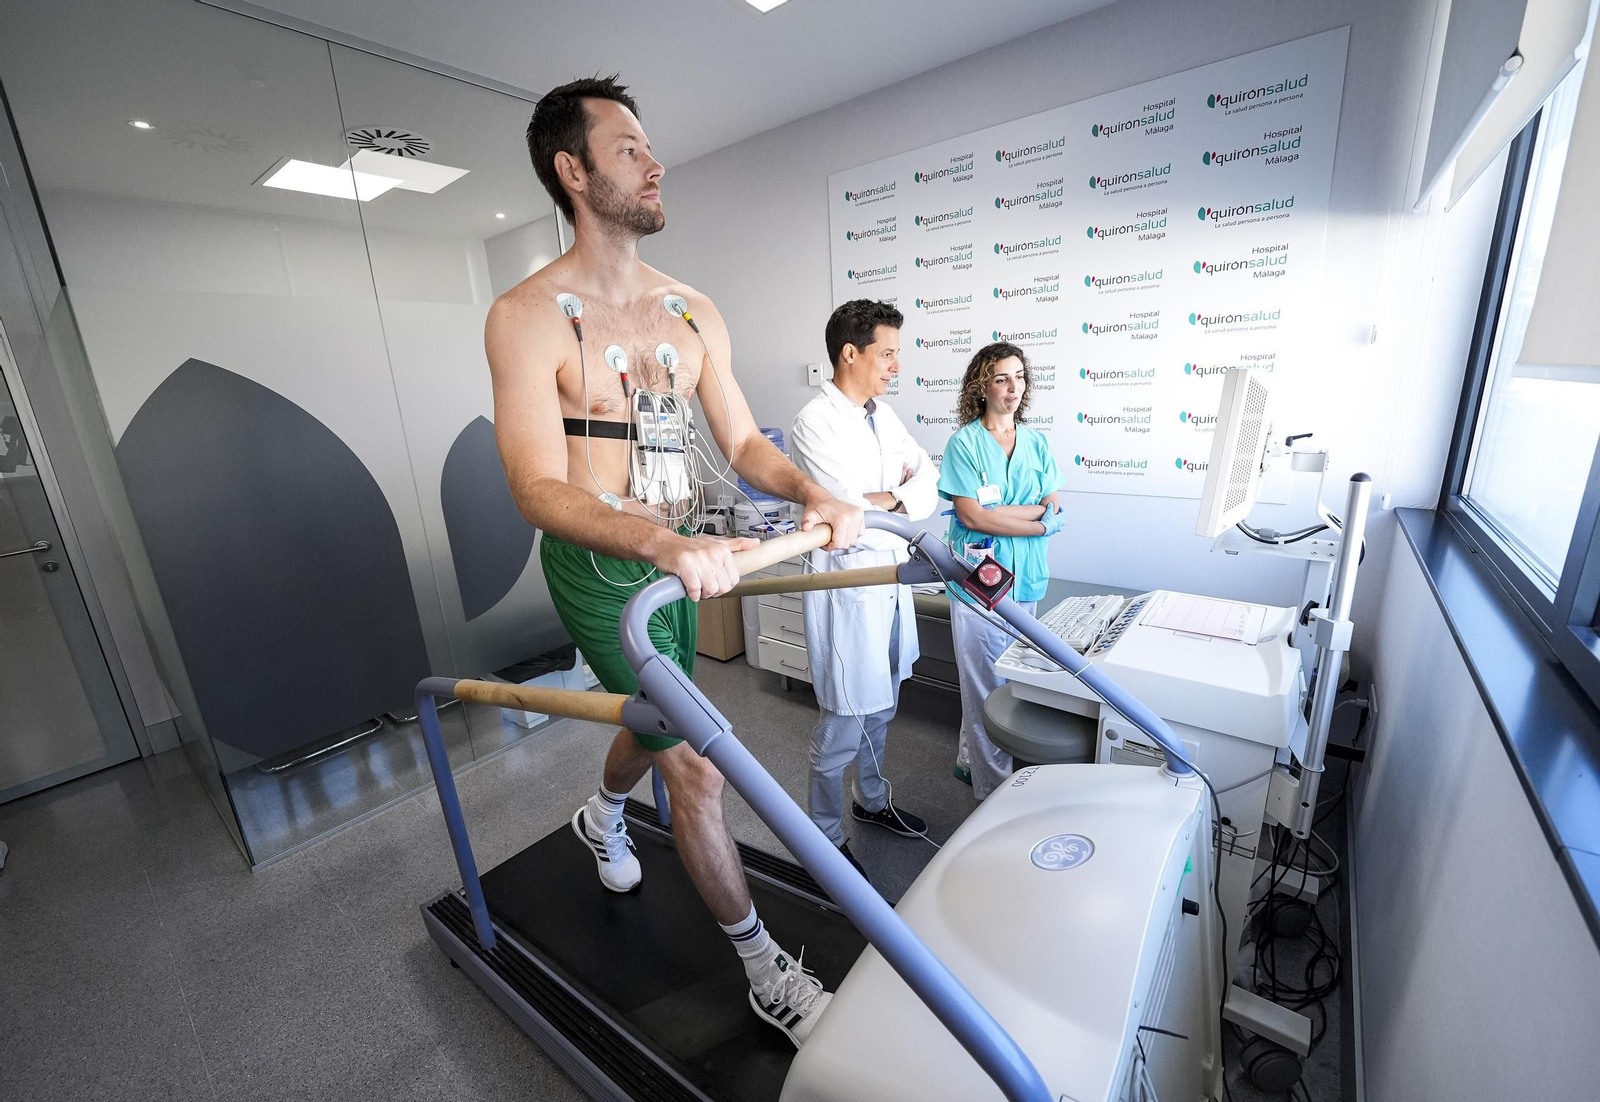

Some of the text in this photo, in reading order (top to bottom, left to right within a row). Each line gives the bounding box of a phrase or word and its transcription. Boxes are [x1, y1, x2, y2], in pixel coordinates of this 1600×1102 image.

[1143, 98, 1176, 112] Hospital
[1249, 101, 1272, 110] persona
[1279, 93, 1303, 103] persona
[1145, 124, 1173, 136] Málaga
[1264, 125, 1302, 140] Hospital
[951, 152, 973, 163] Hospital
[1265, 154, 1299, 165] Málaga
[953, 174, 973, 183] Málaga
[1037, 178, 1064, 189] Hospital
[1124, 184, 1142, 192] persona
[1039, 201, 1062, 210] Málaga
[1137, 208, 1168, 218] Hospital
[877, 216, 896, 225] Hospital
[1238, 216, 1260, 225] persona
[1138, 232, 1165, 241] Málaga
[950, 243, 972, 251] Hospital
[1252, 243, 1289, 254] Hospital
[1034, 274, 1059, 282] Hospital
[1253, 270, 1285, 278] Málaga
[1130, 310, 1160, 318] Hospital
[1012, 766, 1040, 787] T2100
